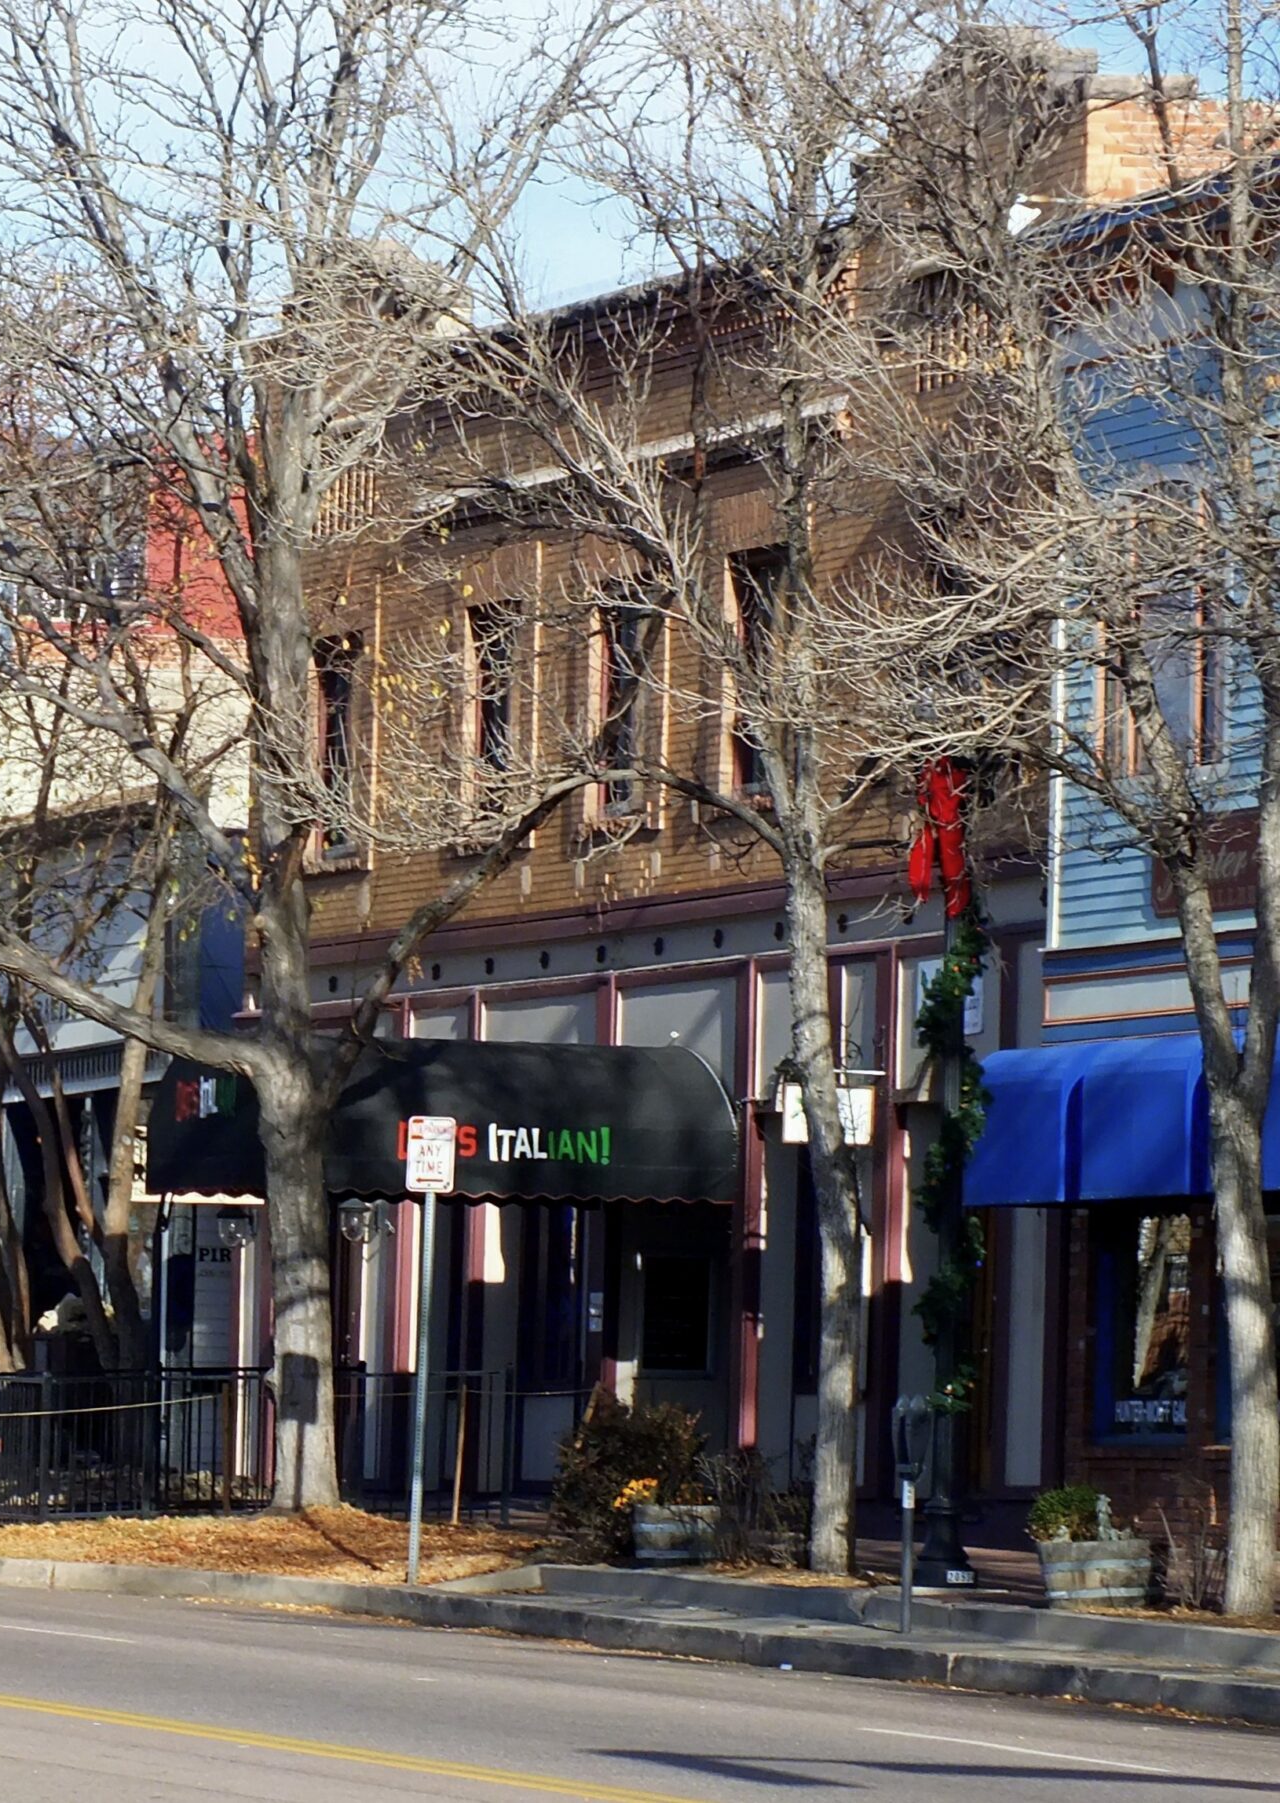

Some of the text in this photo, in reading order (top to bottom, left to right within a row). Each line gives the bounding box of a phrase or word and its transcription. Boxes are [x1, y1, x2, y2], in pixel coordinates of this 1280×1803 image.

[418, 1145, 442, 1158] ANY
[488, 1123, 610, 1165] ITALIAN!
[416, 1160, 443, 1175] TIME
